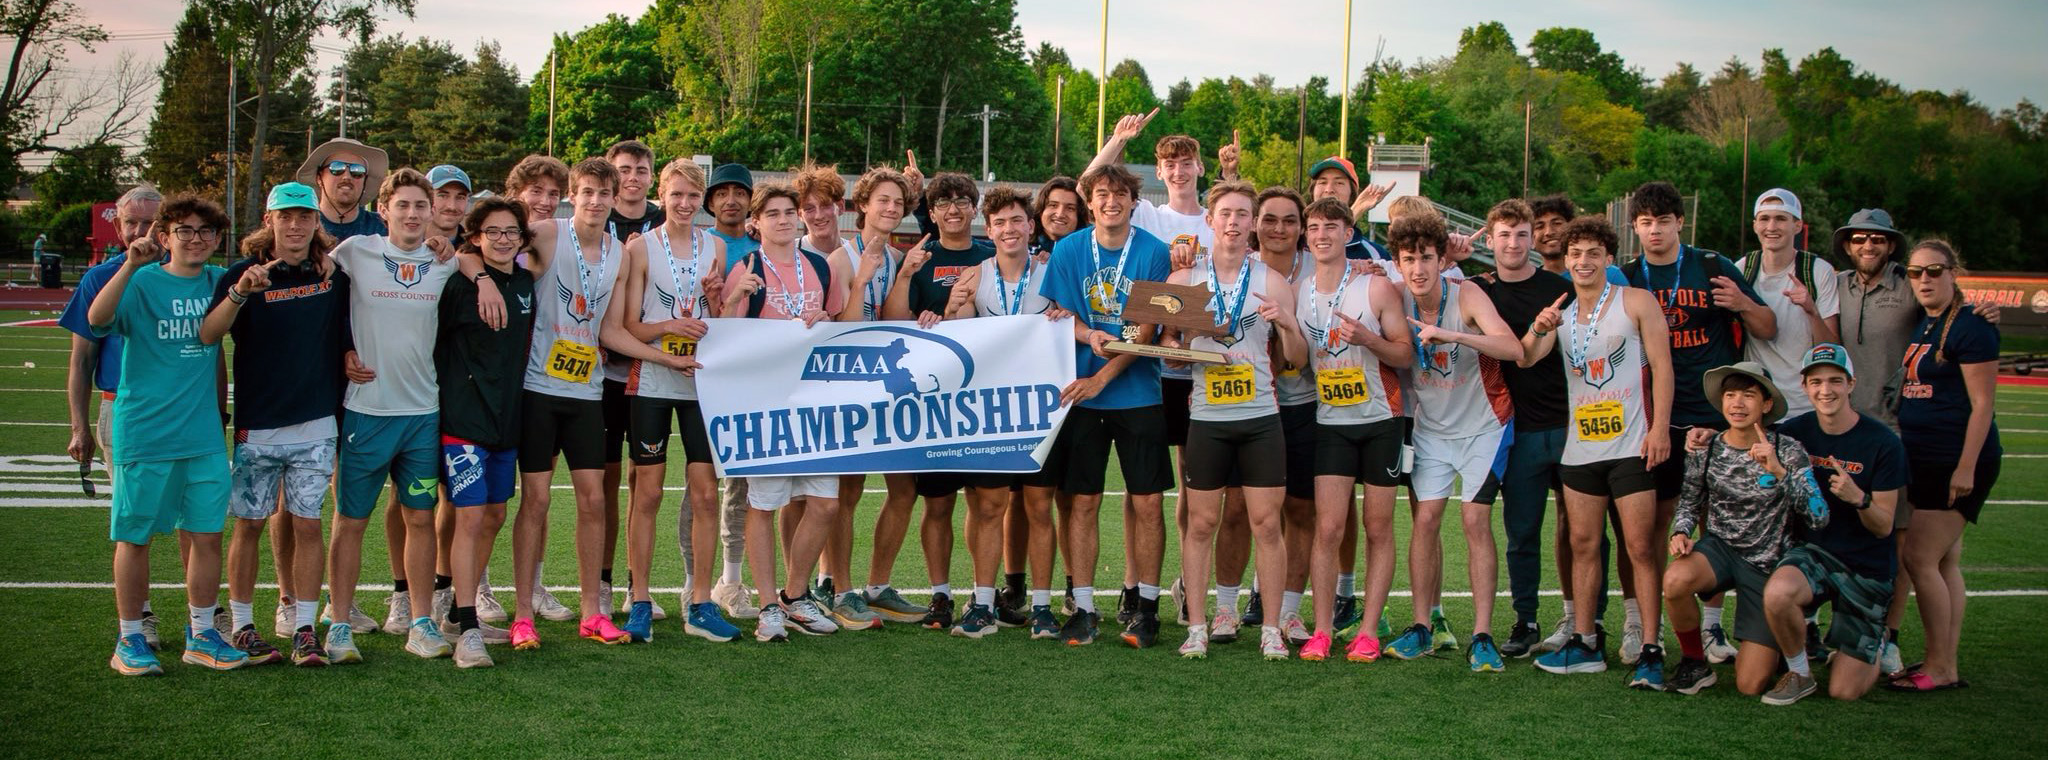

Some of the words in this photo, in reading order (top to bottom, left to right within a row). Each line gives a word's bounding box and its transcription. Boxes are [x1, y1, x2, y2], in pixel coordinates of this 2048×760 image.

[265, 285, 318, 302] WALPOLE
[371, 290, 399, 299] CROSS
[1657, 288, 1708, 308] LOLE
[1962, 289, 2024, 308] SEBALL
[172, 296, 213, 317] GAM
[158, 318, 203, 340] CHAN
[1673, 328, 1709, 349] BALL
[668, 342, 697, 356] 547
[553, 353, 592, 377] 5474
[810, 353, 891, 374] MIAA
[1212, 378, 1251, 398] 5461
[1322, 382, 1365, 401] 5464
[709, 384, 1062, 464] CHAMPIONSHIP
[1580, 415, 1623, 437] 5456
[926, 449, 963, 459] Growing
[964, 444, 1017, 455] Courageous
